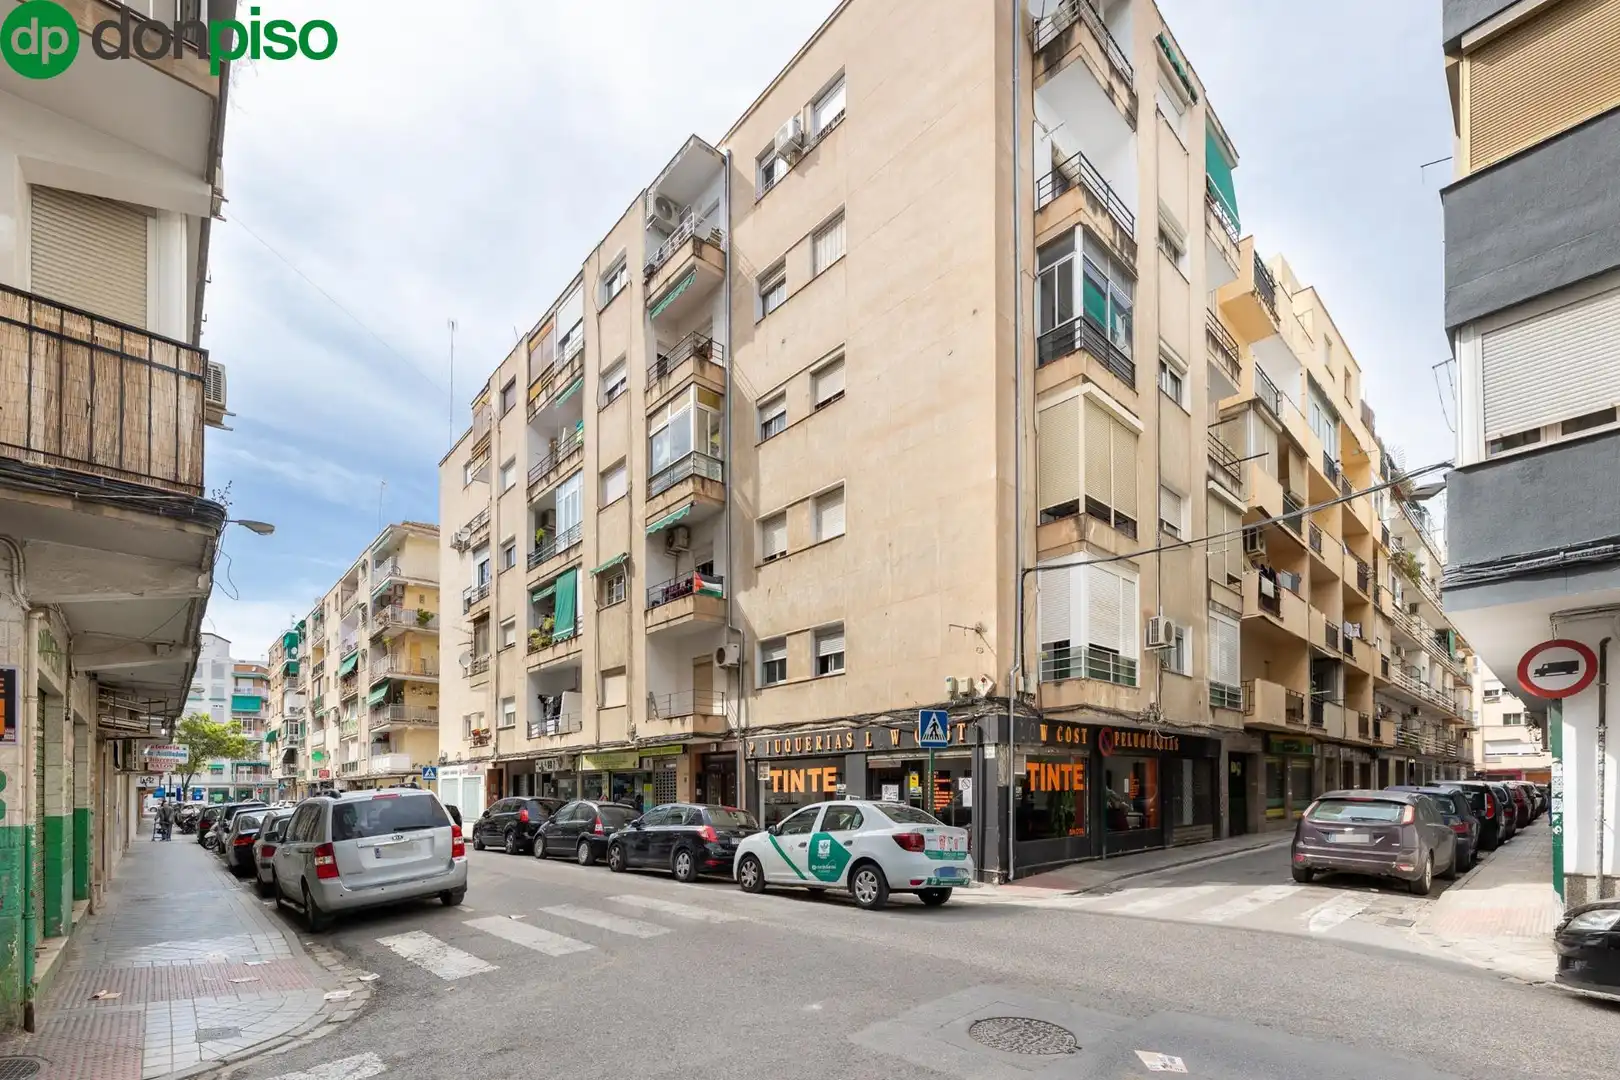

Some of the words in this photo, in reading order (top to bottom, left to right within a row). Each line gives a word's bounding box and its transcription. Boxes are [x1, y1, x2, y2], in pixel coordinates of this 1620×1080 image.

[1056, 725, 1088, 744] COST
[769, 766, 837, 793] TINTE
[1026, 762, 1084, 792] TINTE
